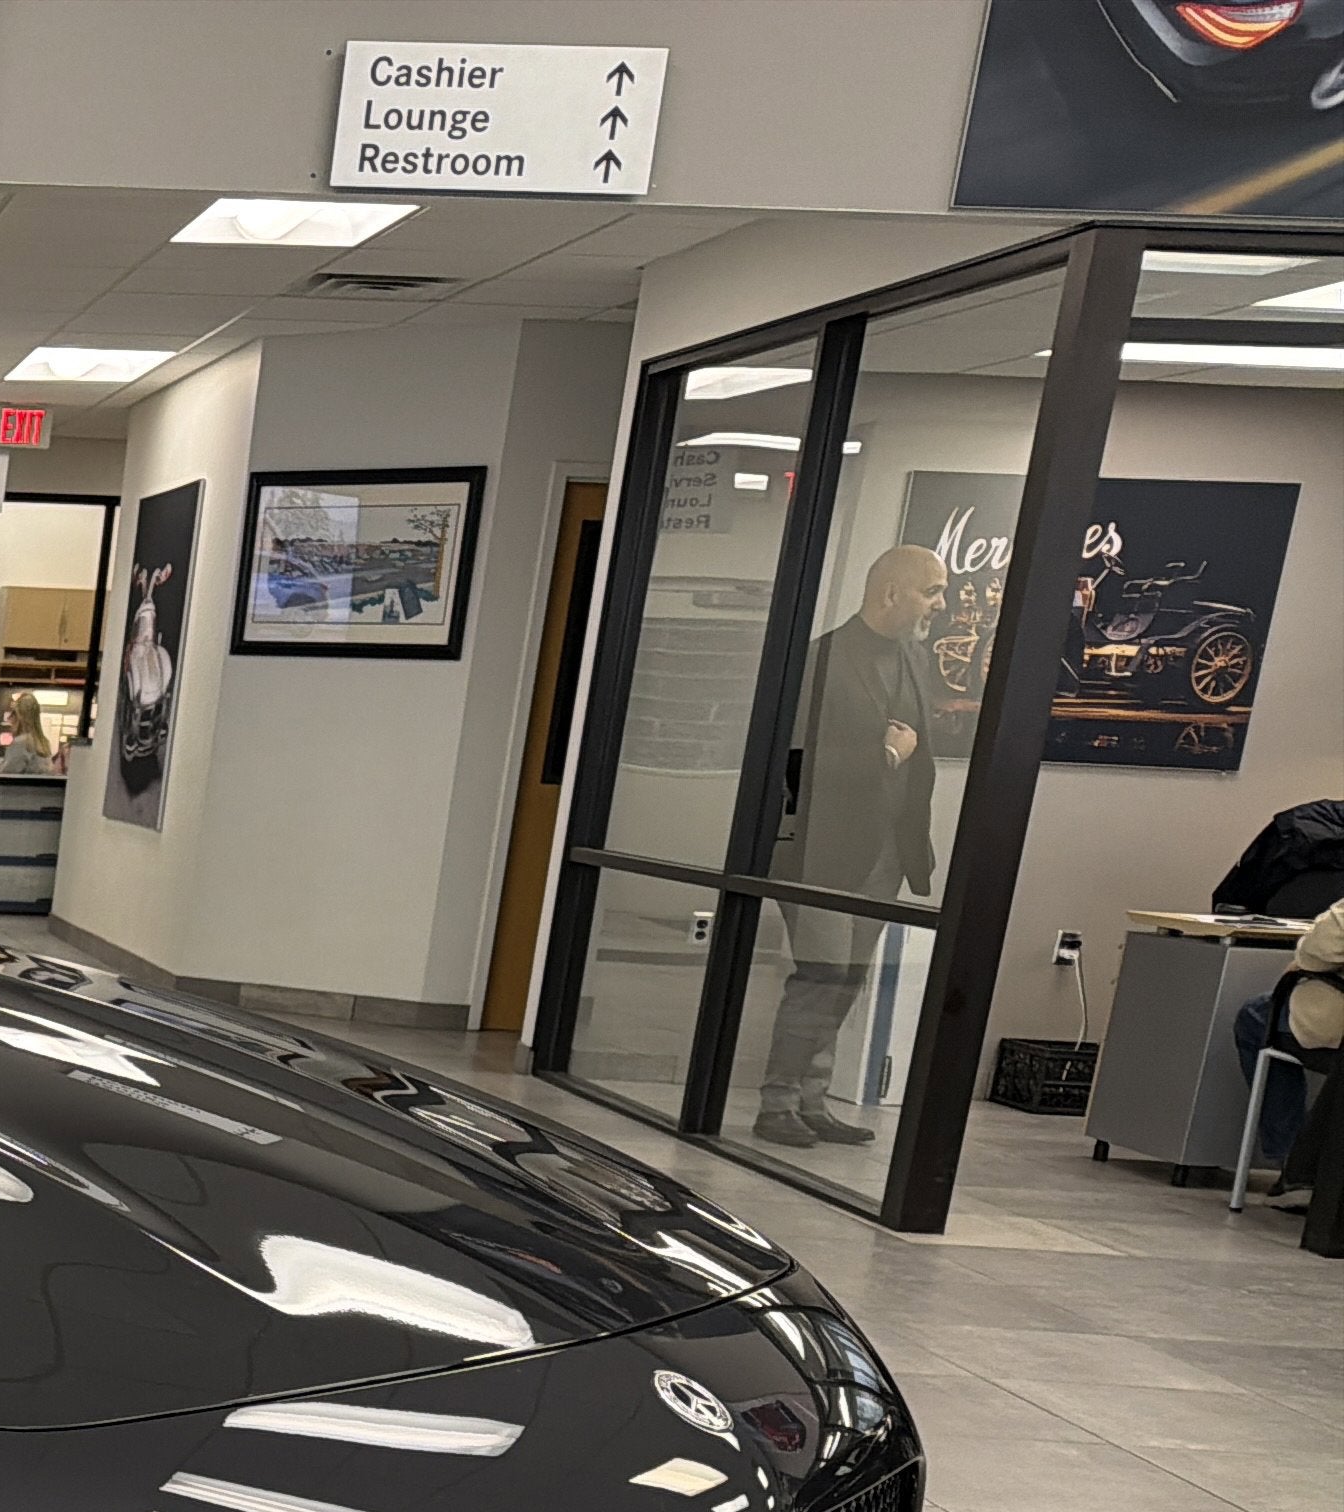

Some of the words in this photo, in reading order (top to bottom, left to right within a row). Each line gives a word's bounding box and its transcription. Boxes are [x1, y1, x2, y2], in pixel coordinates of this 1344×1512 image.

[370, 56, 504, 89] Cashier
[363, 99, 490, 140] Lounge
[358, 143, 526, 177] Restroom
[0, 407, 46, 446] EXIT
